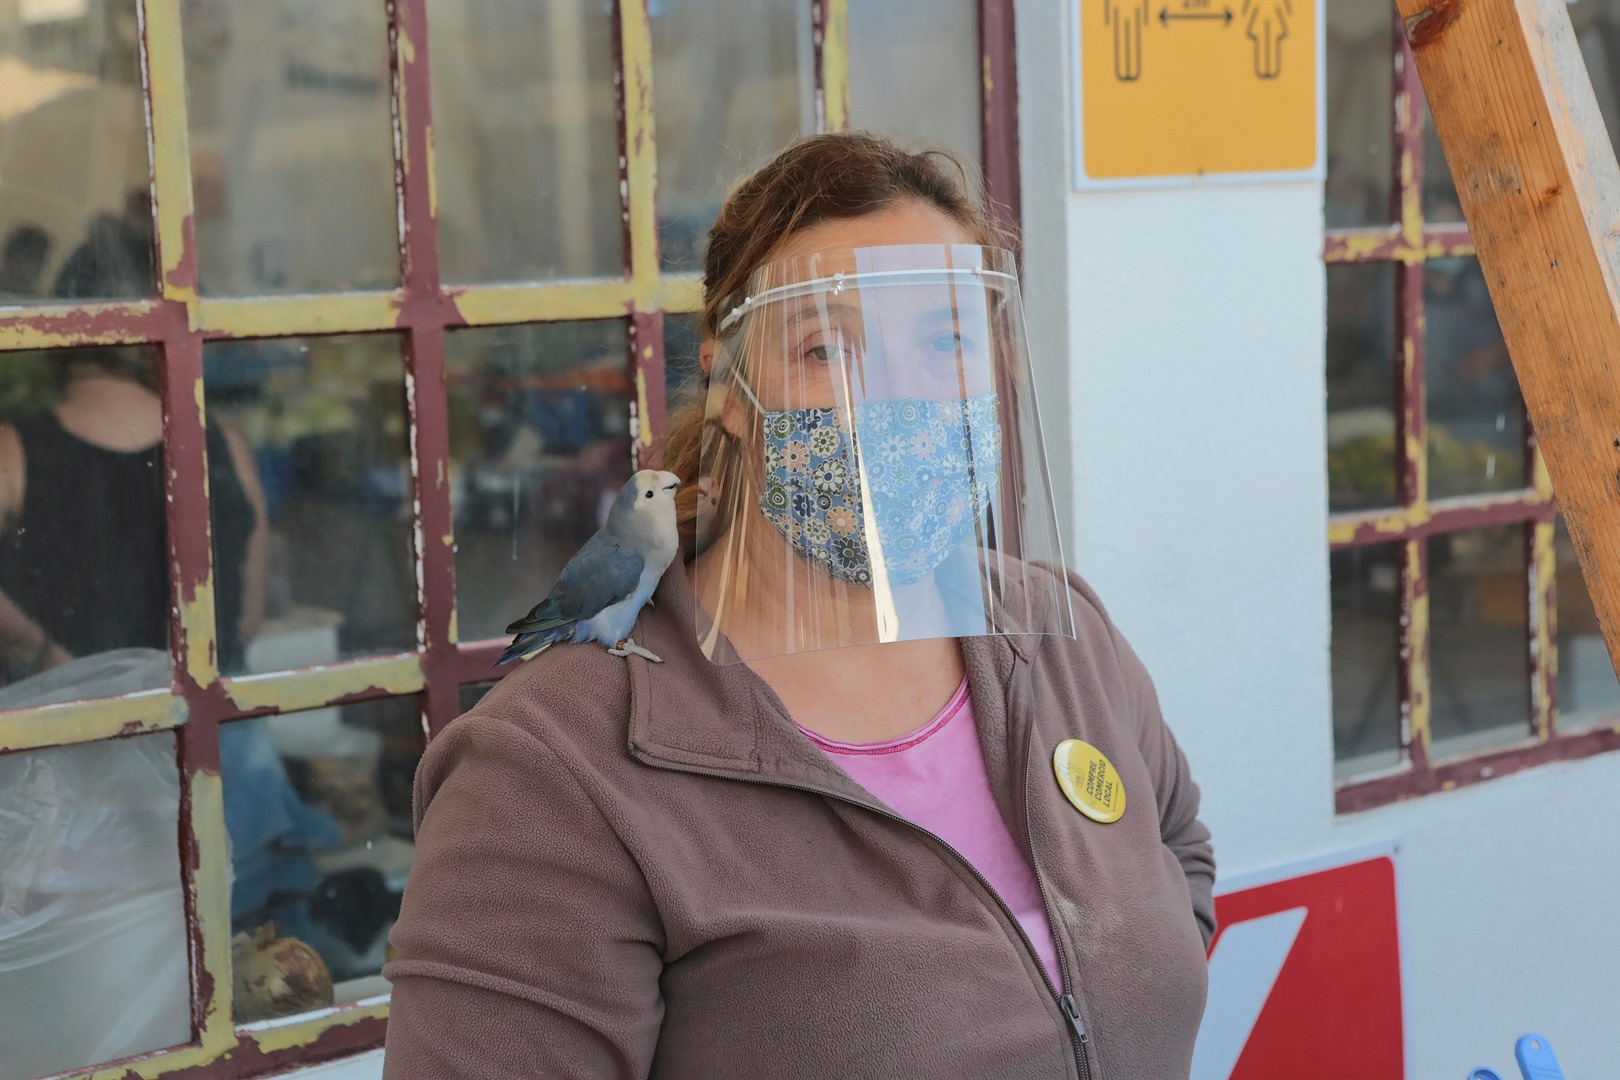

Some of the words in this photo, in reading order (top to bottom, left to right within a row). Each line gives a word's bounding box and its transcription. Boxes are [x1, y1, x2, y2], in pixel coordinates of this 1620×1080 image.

[1086, 760, 1097, 795] COMPRE
[1095, 759, 1106, 801] COMERCIO
[1103, 781, 1113, 807] LOCAL
